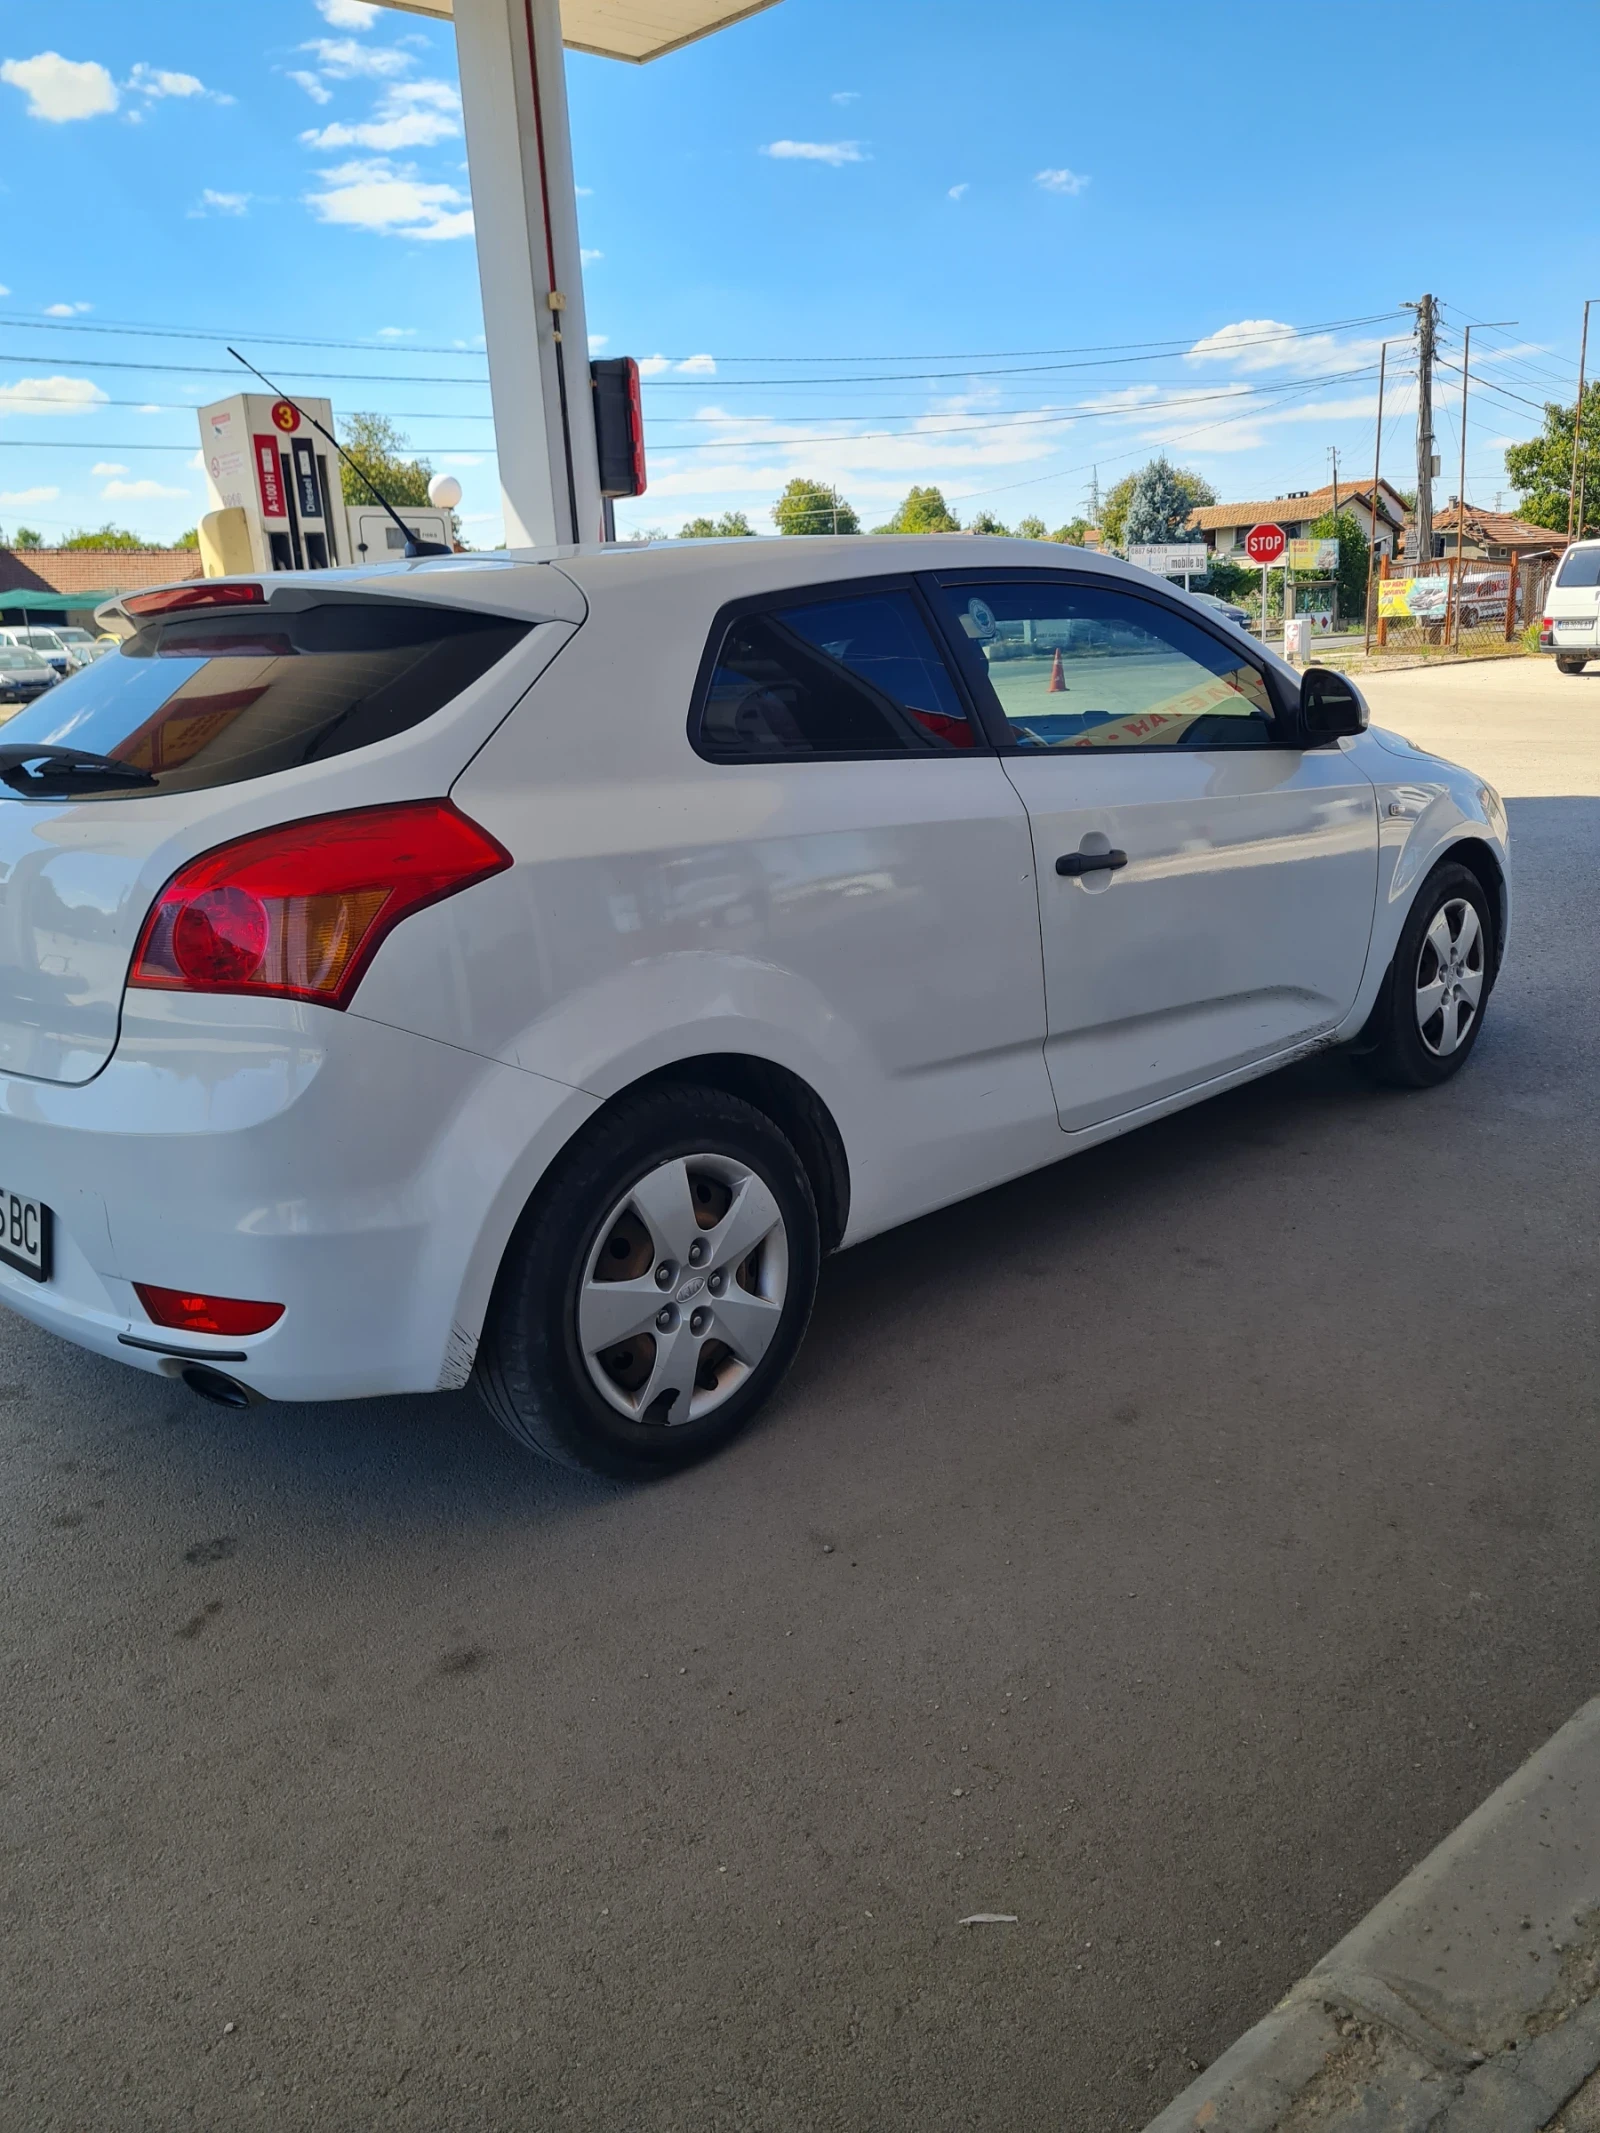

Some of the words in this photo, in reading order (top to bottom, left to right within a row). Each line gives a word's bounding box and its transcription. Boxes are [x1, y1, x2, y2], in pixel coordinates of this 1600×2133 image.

[278, 405, 294, 429] 3
[302, 478, 316, 513] Diesel
[1131, 547, 1146, 555] 0887
[1146, 547, 1157, 555] 640
[1157, 546, 1168, 554] 018
[1250, 535, 1282, 552] STOP
